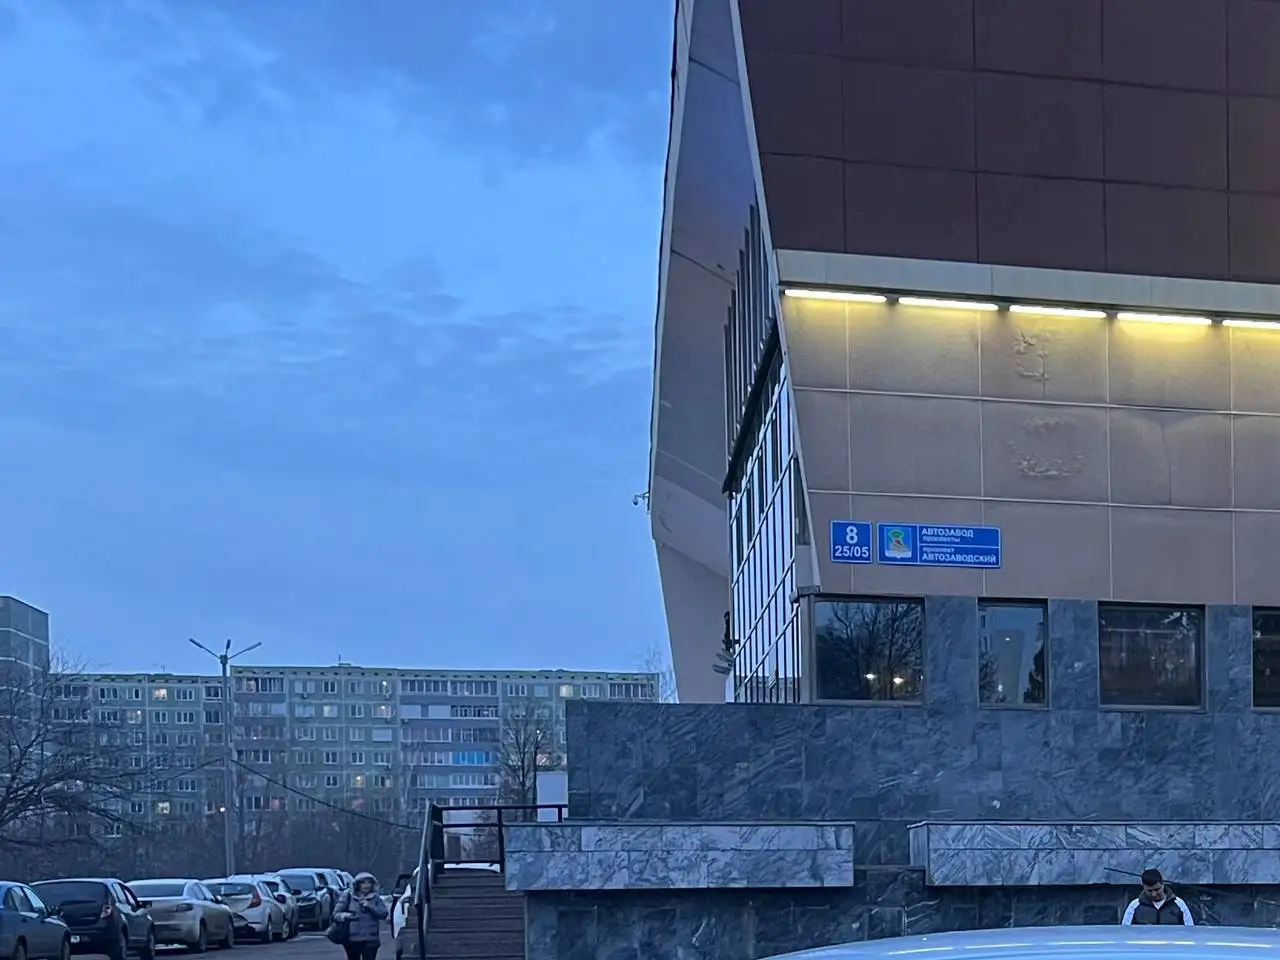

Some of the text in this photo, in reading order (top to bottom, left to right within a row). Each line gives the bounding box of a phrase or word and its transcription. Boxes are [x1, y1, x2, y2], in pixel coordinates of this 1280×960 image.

[846, 525, 858, 544] 8
[921, 527, 974, 538] АВТОЗАВОД
[834, 545, 869, 558] 25/05
[922, 552, 997, 564] АВТОЗАВОДСКИЙ
